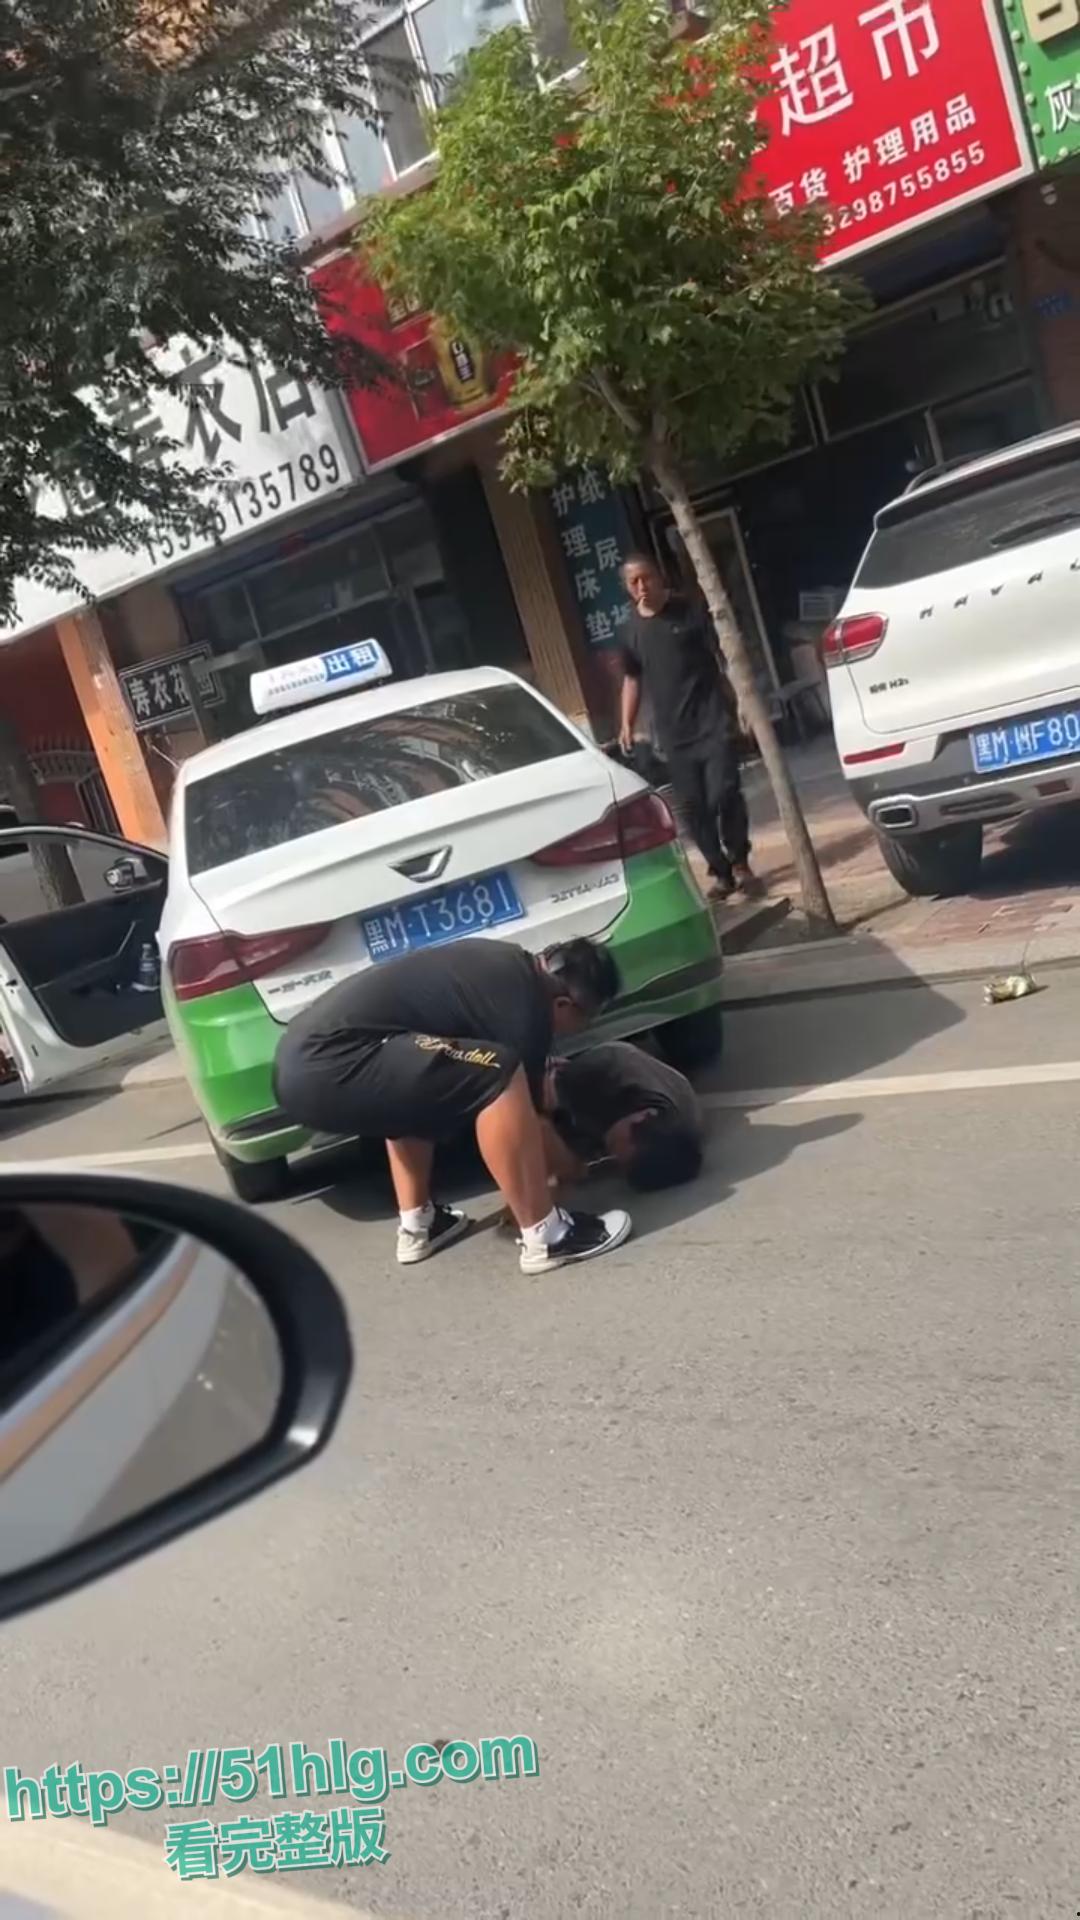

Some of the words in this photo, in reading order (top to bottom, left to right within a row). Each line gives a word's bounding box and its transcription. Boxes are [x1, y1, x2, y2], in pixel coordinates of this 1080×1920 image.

[770, 0, 940, 137] 超市
[768, 167, 829, 219] 百货
[842, 93, 977, 184] 护理用品
[552, 481, 615, 644] 护理床垫
[326, 643, 376, 675] 出租
